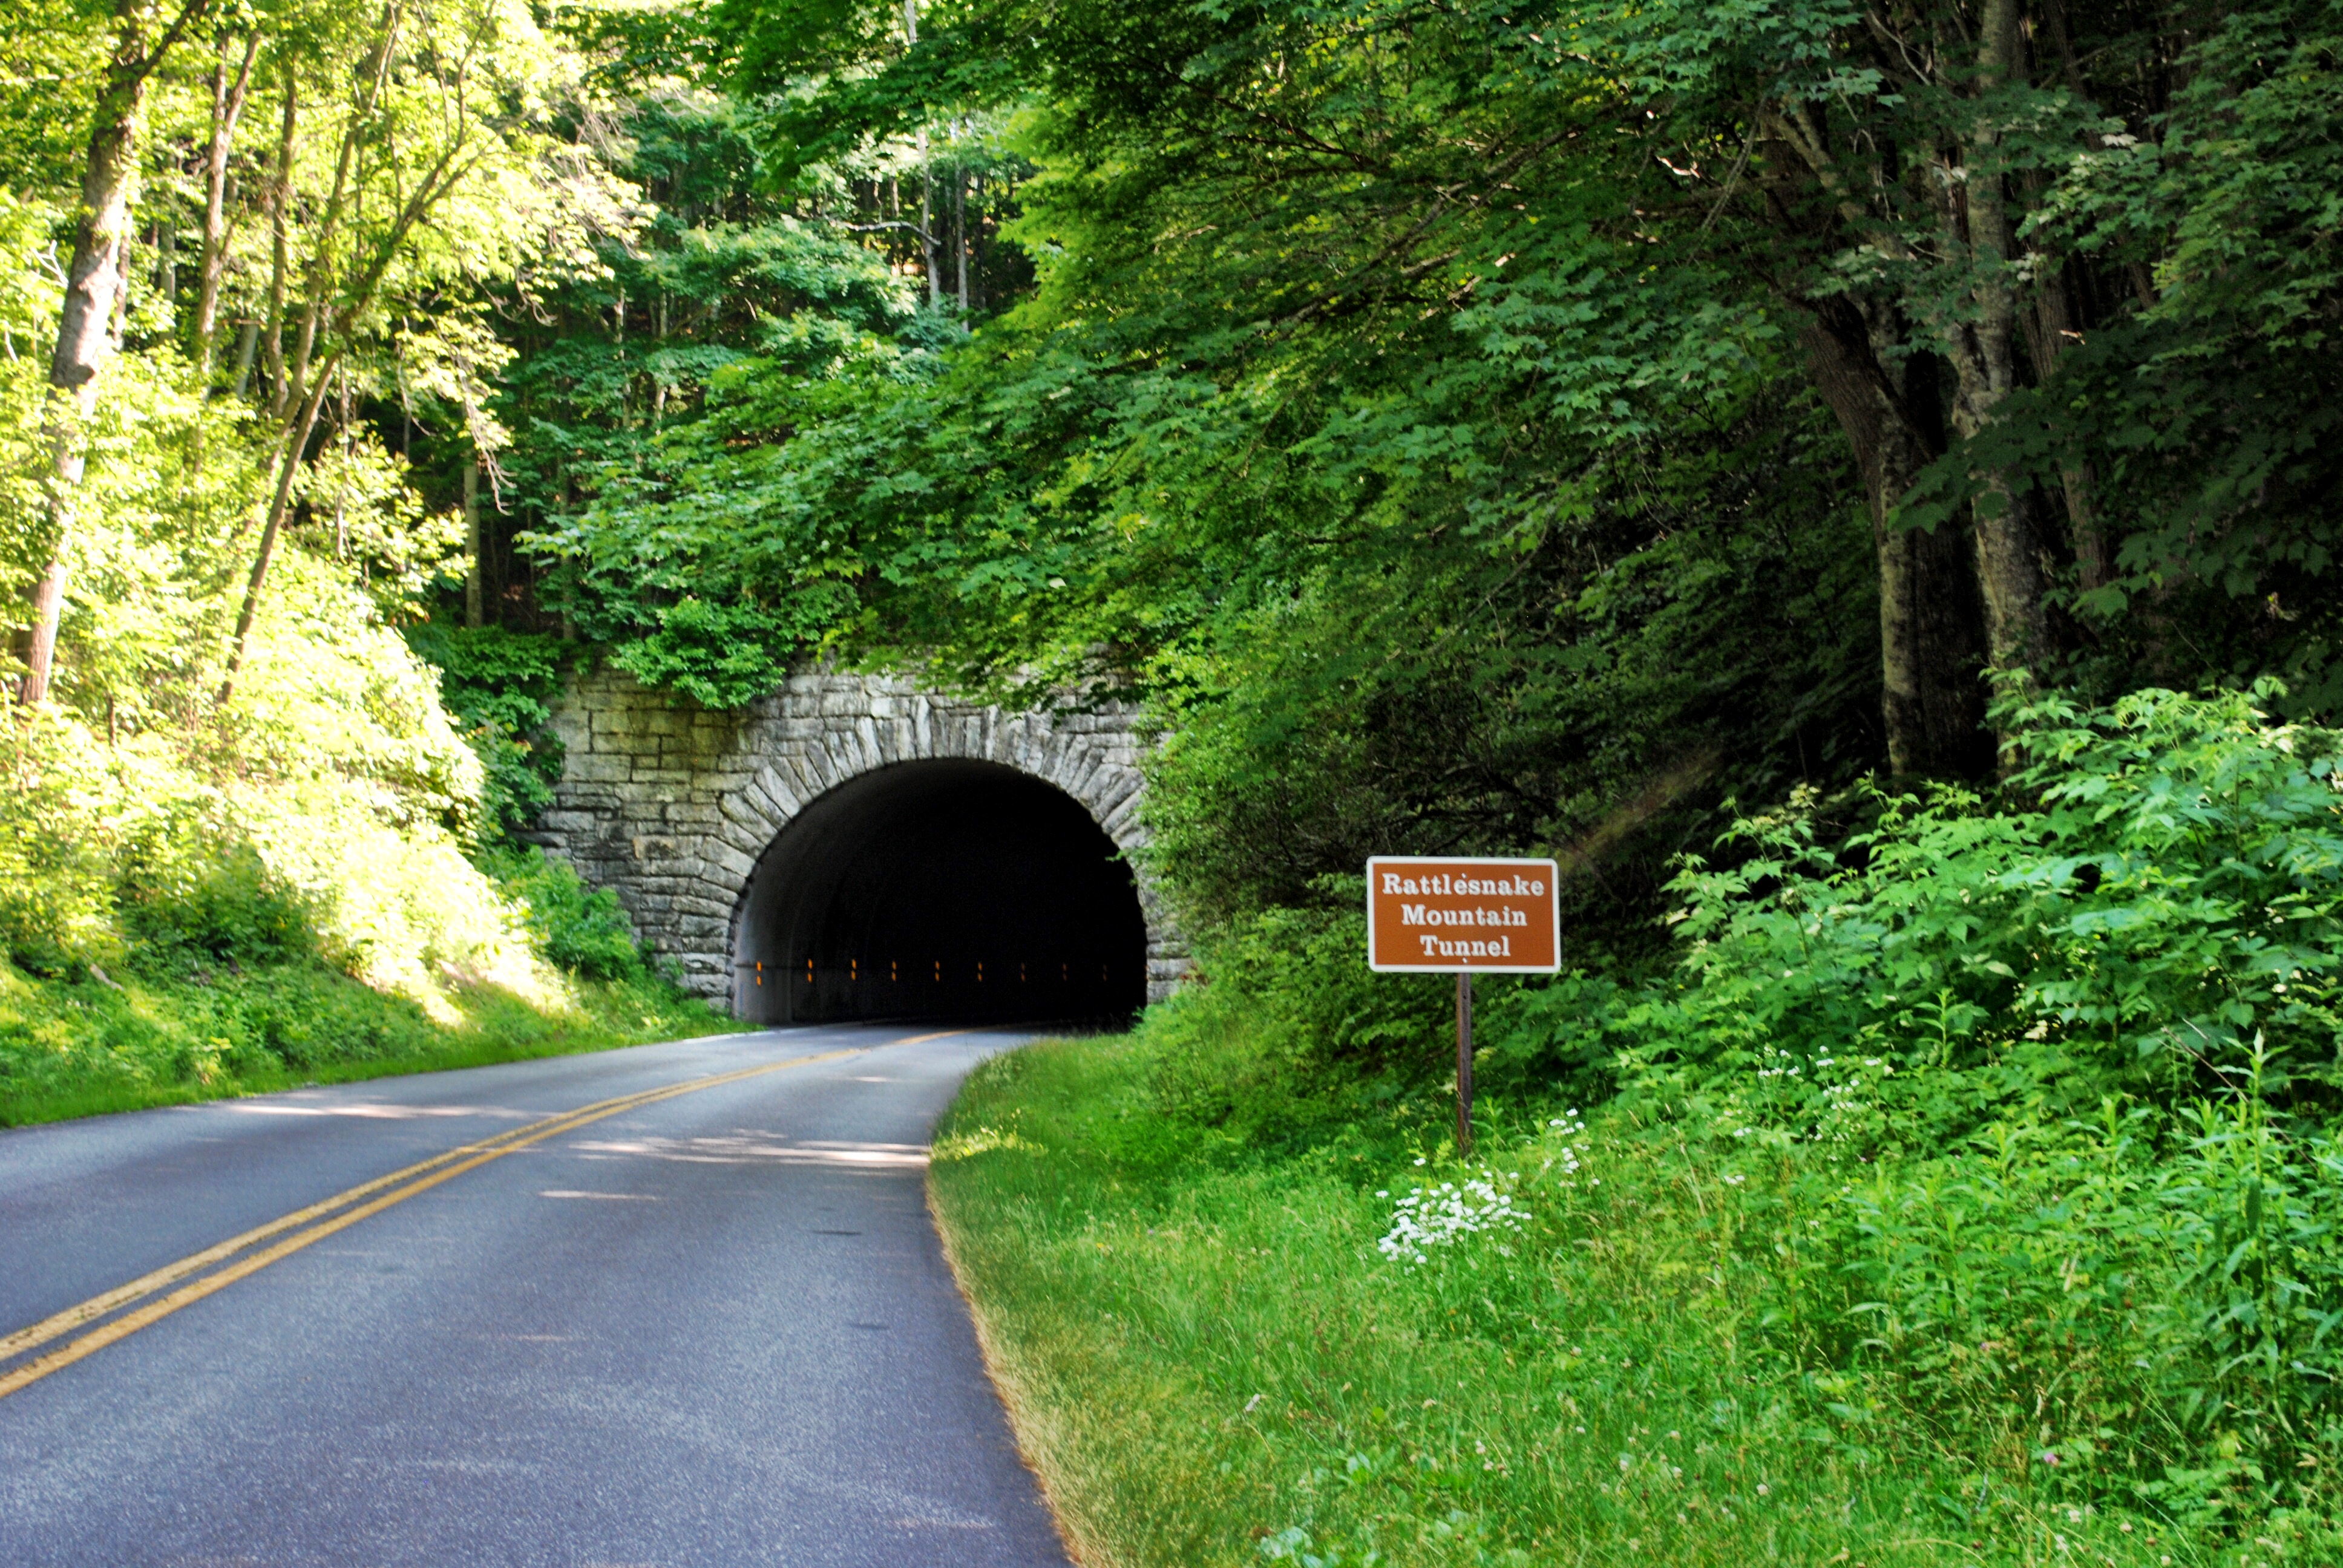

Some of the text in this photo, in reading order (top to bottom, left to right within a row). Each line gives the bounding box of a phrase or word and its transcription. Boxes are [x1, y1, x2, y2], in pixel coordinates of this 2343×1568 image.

[1382, 873, 1544, 897] Rattlesnake
[1401, 904, 1527, 927] Mountain
[1420, 935, 1511, 957] Tunnel
